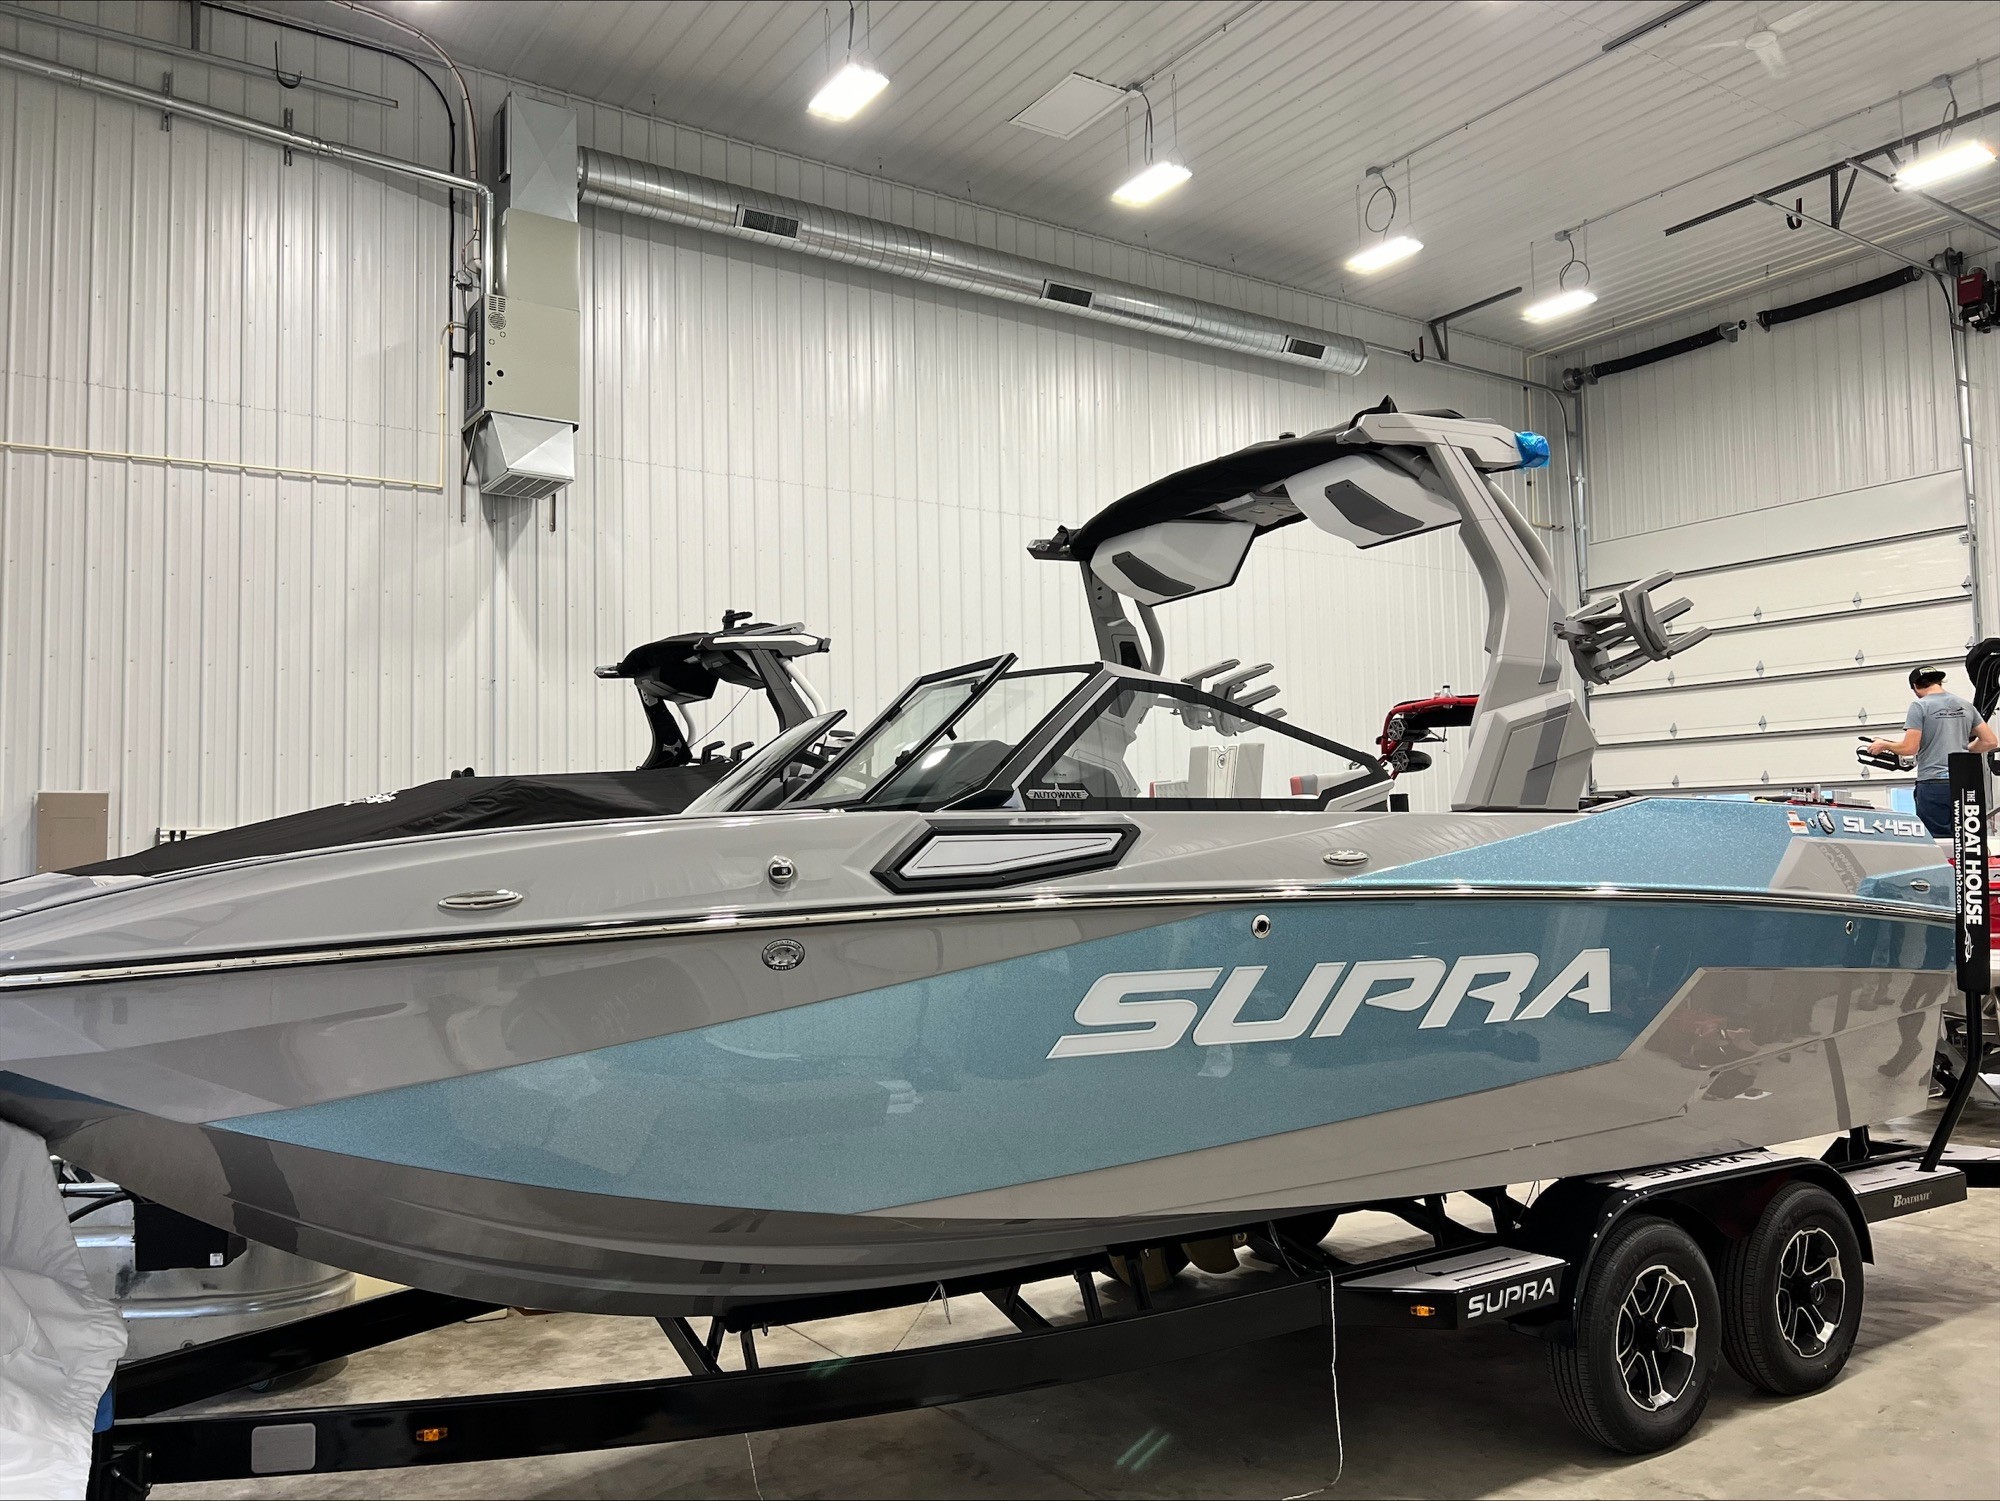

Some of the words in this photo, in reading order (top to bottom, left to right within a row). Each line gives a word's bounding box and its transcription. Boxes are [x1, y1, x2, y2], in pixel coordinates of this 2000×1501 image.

[1033, 790, 1082, 799] AUTOWAKE
[1966, 790, 1976, 802] THE
[1964, 804, 1982, 856] BOAT
[1953, 799, 1964, 914] www.boathouseh2o.com
[1965, 859, 1983, 926] HOUSE
[1045, 948, 1612, 1059] SUPRA
[1637, 1154, 1757, 1180] SUPRA
[1467, 1277, 1556, 1319] SUPRA
